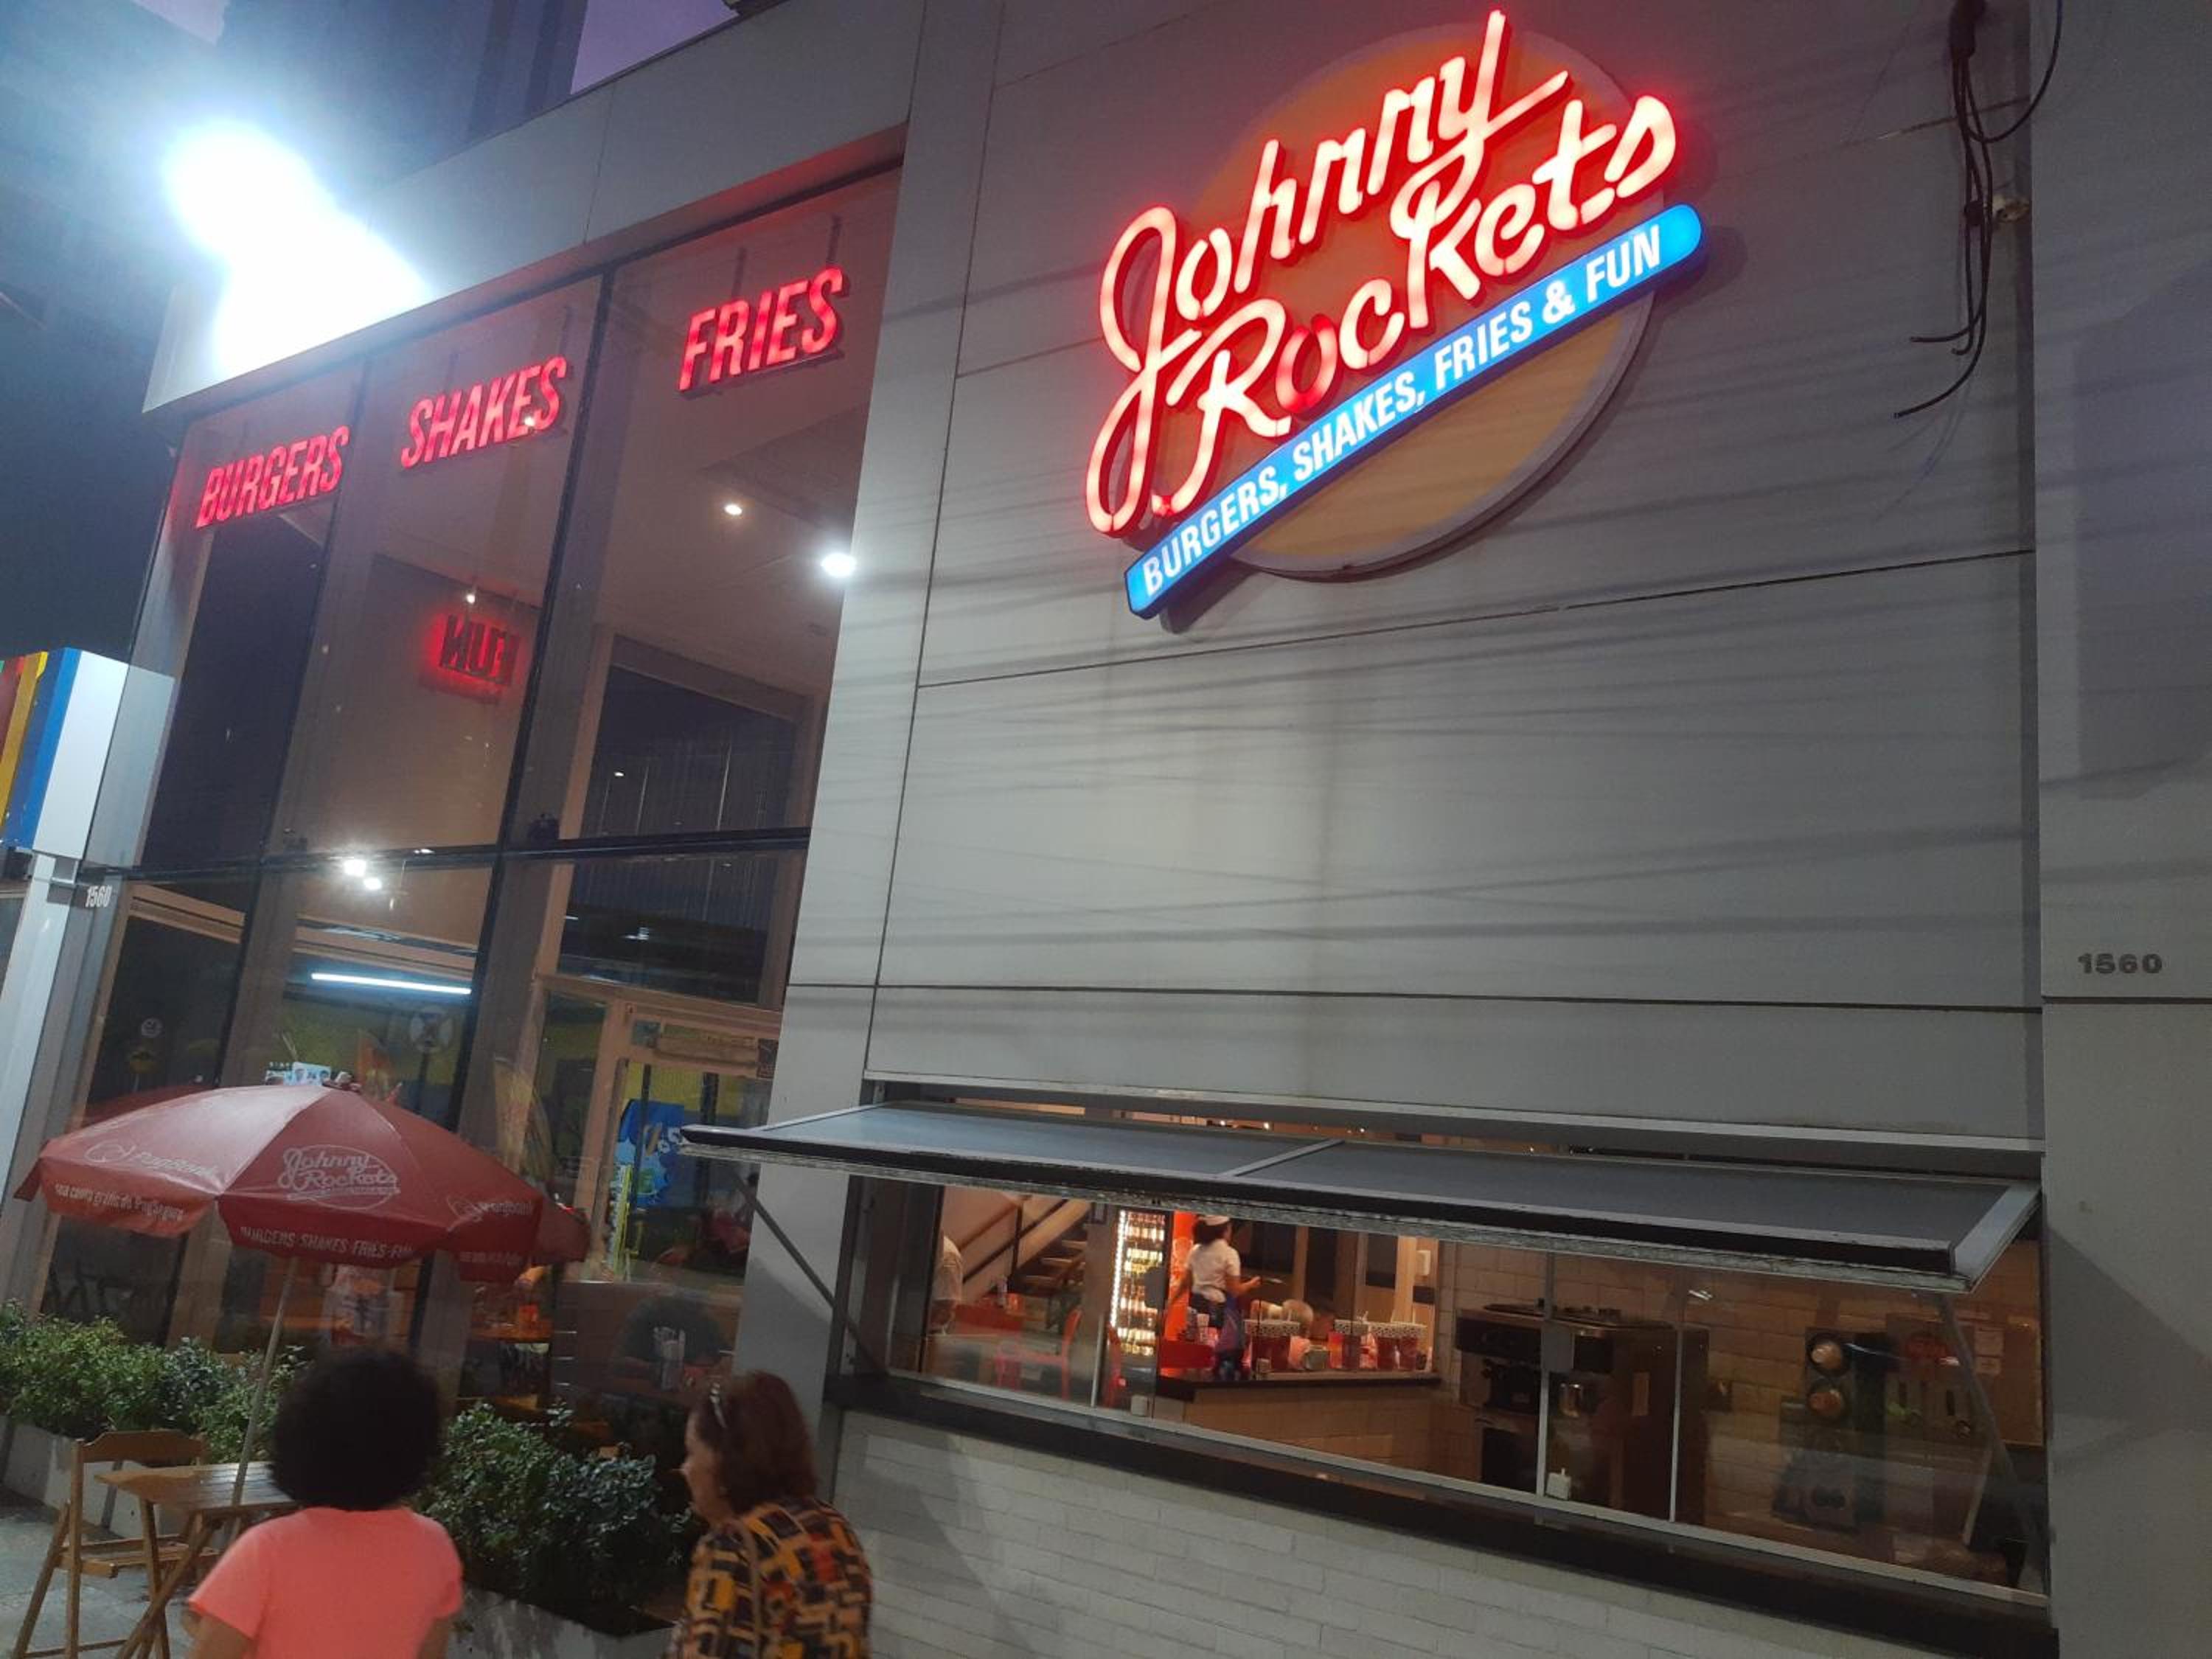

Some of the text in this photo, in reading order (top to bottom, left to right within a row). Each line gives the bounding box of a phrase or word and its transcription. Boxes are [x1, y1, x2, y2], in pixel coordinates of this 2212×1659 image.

[1085, 9, 1571, 536] Johnny
[678, 266, 844, 392] FRIES
[400, 355, 568, 469] SHAKES
[1141, 223, 1661, 597] BURGERS, SHAKES, FRIES & FUN
[195, 424, 349, 529] BURGERS
[85, 885, 113, 908] 1560
[2077, 953, 2163, 974] 1560
[277, 1147, 381, 1192] Johnny
